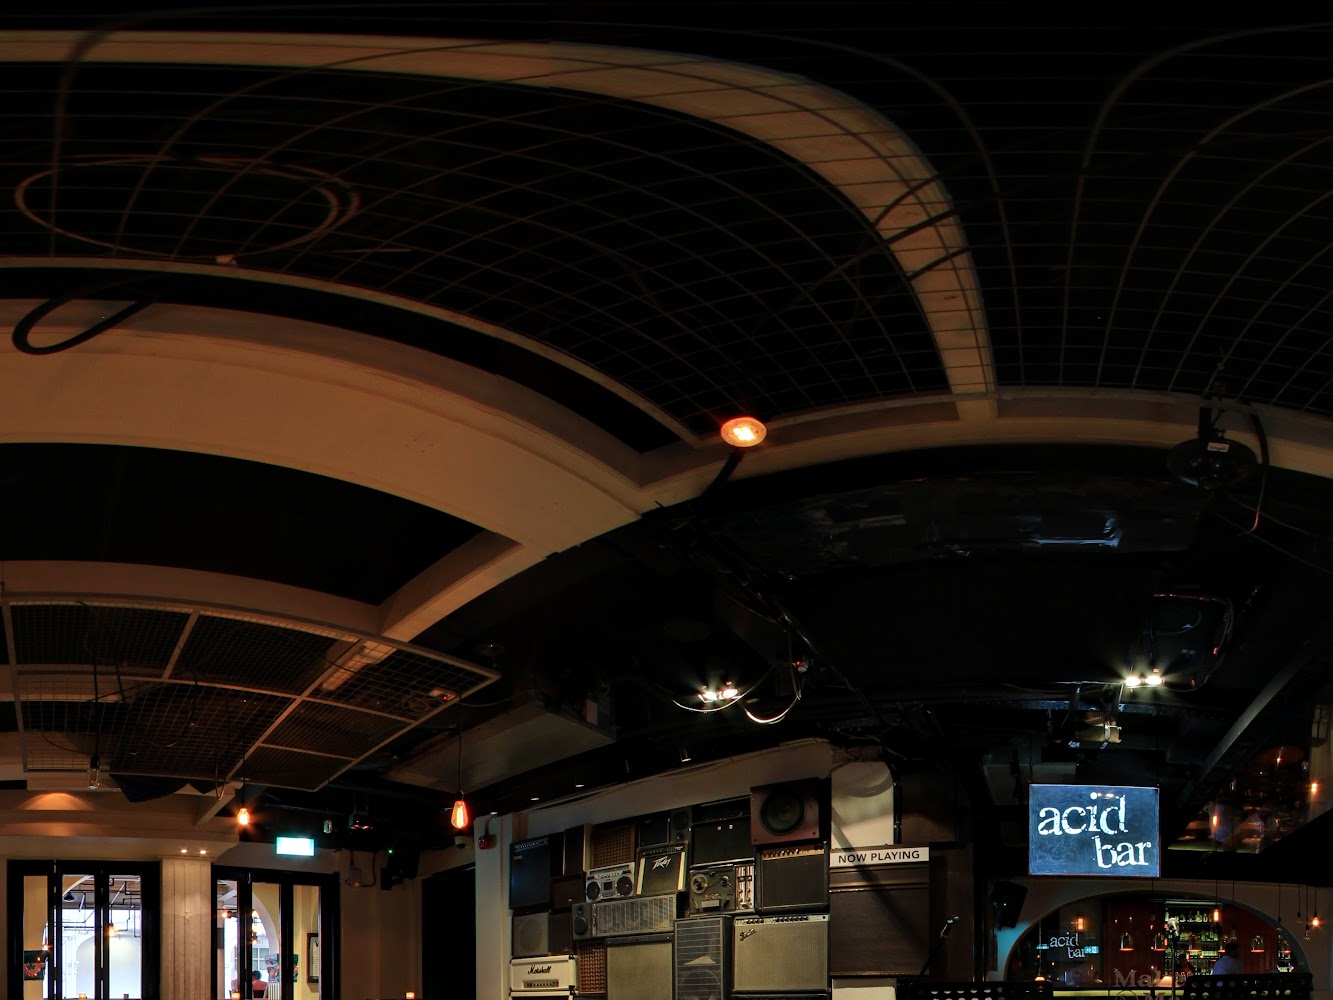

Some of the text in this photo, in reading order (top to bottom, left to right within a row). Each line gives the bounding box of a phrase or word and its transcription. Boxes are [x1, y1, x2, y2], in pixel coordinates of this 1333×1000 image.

[1038, 792, 1128, 835] acid
[838, 850, 920, 863] NOW PLAYING
[1091, 835, 1152, 868] bar
[1050, 931, 1080, 948] acid
[1067, 947, 1086, 959] bar
